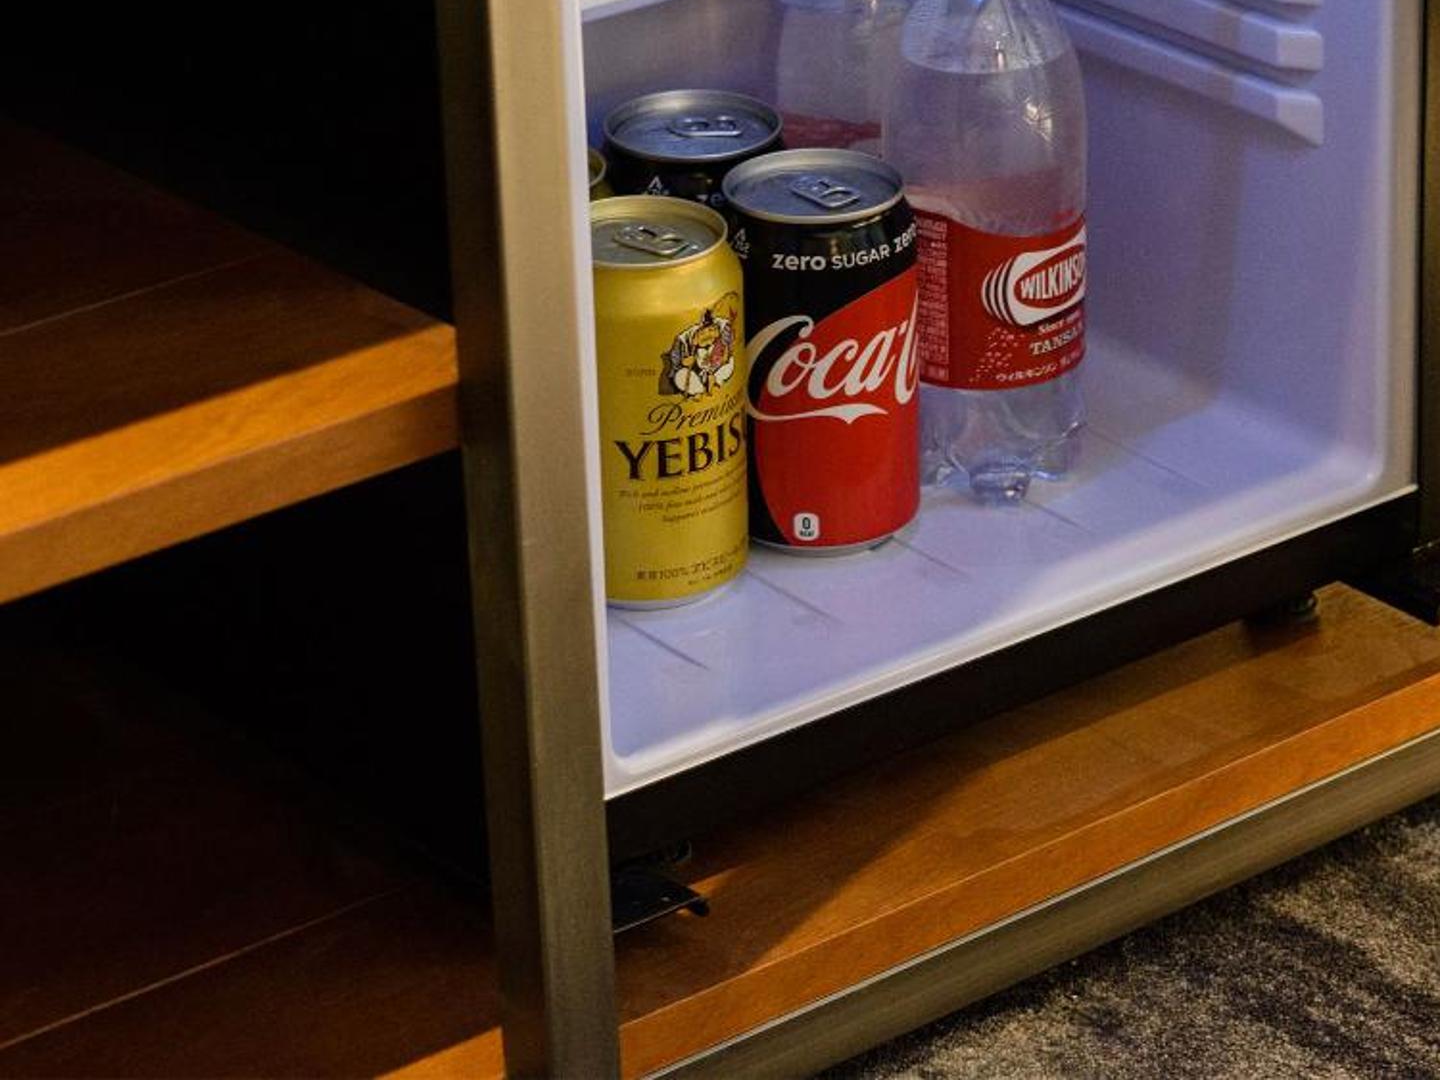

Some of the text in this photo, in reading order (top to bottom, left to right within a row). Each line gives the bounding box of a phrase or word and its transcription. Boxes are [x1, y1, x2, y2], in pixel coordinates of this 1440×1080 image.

[771, 222, 917, 271] zero SUGAR zer
